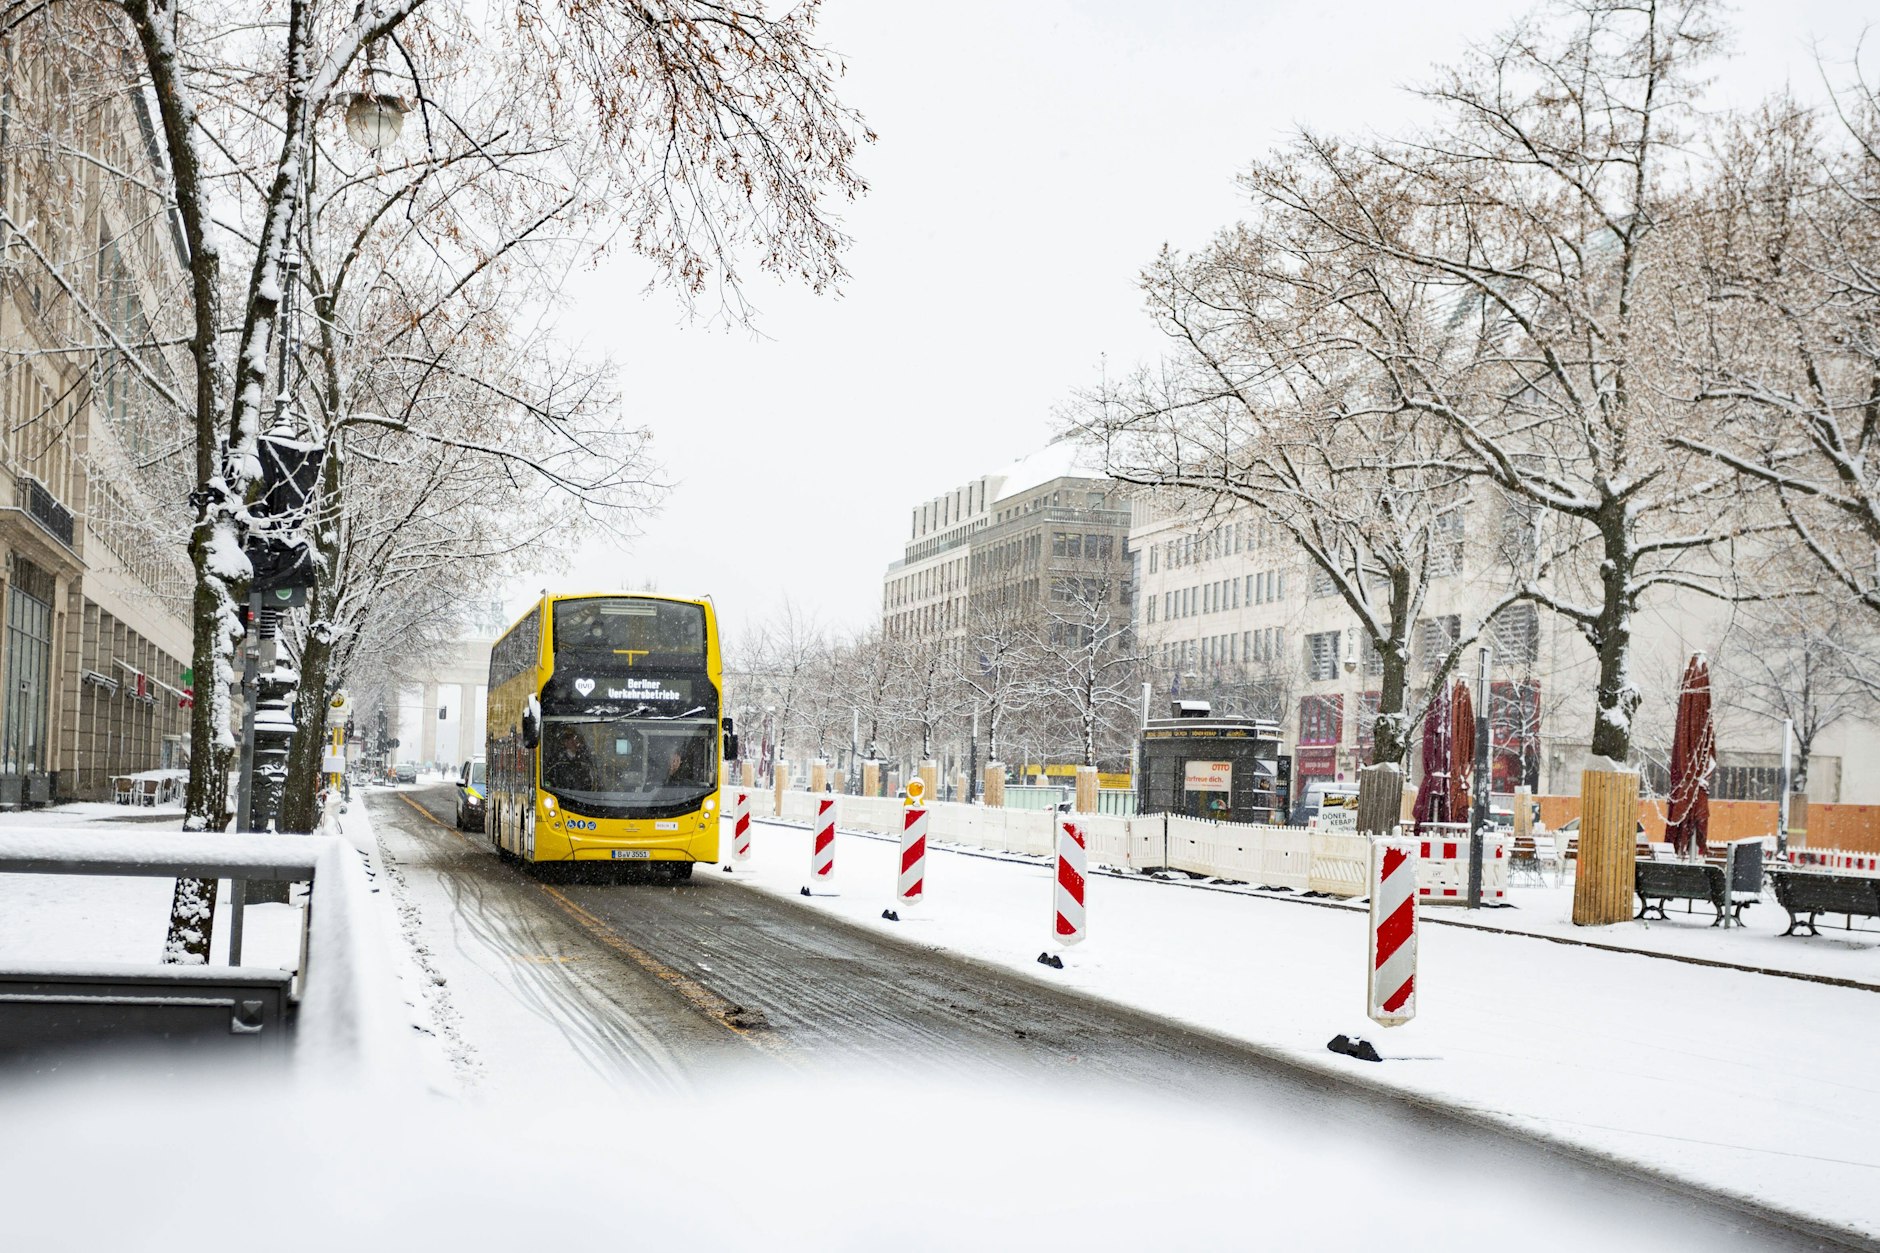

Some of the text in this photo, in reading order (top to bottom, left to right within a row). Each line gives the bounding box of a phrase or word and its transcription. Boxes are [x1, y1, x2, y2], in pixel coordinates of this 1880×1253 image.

[627, 678, 661, 690] Berliner
[608, 688, 680, 700] Verkehrsbetriebe
[1212, 763, 1230, 771] OTTO
[1208, 775, 1224, 783] dich.
[1322, 811, 1347, 820] DÖNER
[1330, 818, 1356, 826] KEBAP?
